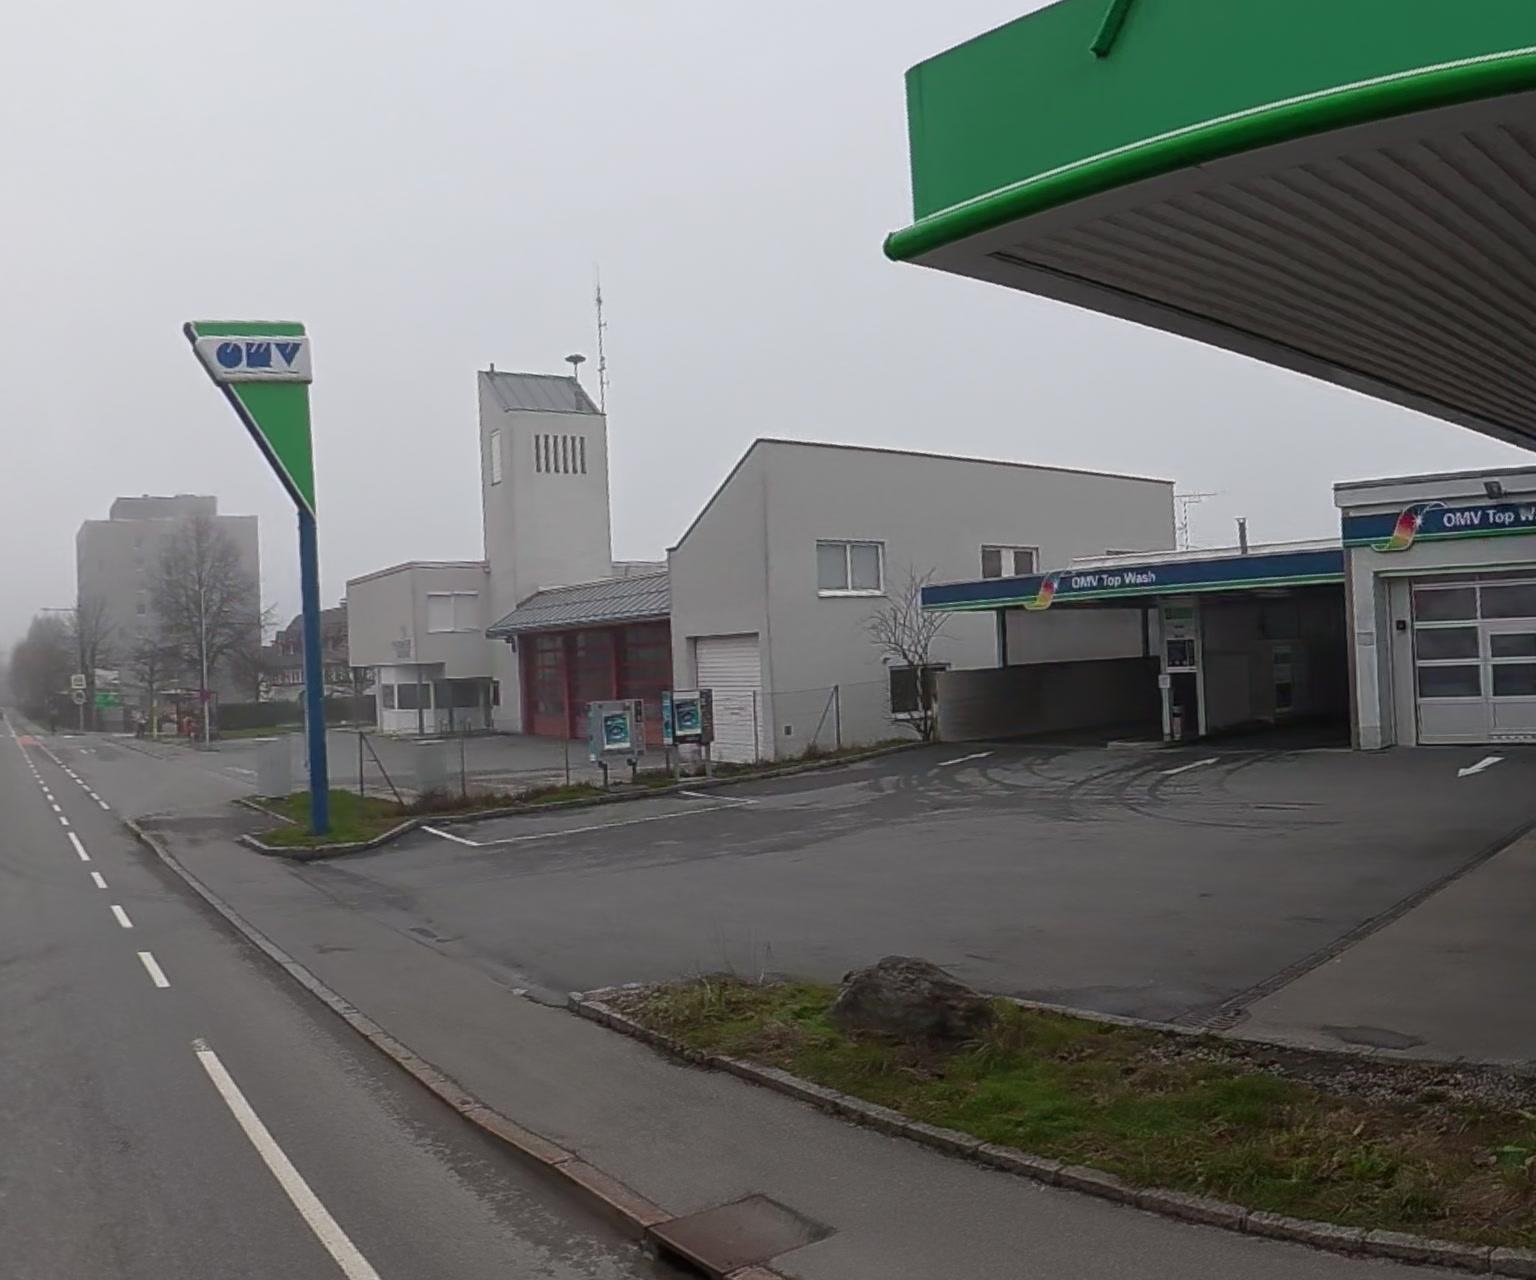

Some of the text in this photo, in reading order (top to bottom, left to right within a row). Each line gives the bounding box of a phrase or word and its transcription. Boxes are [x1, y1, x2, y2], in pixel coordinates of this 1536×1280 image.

[217, 341, 302, 368] OMV
[1443, 510, 1482, 527] OMV
[1486, 509, 1515, 525] Top
[1071, 571, 1156, 589] OMV Top Wash
